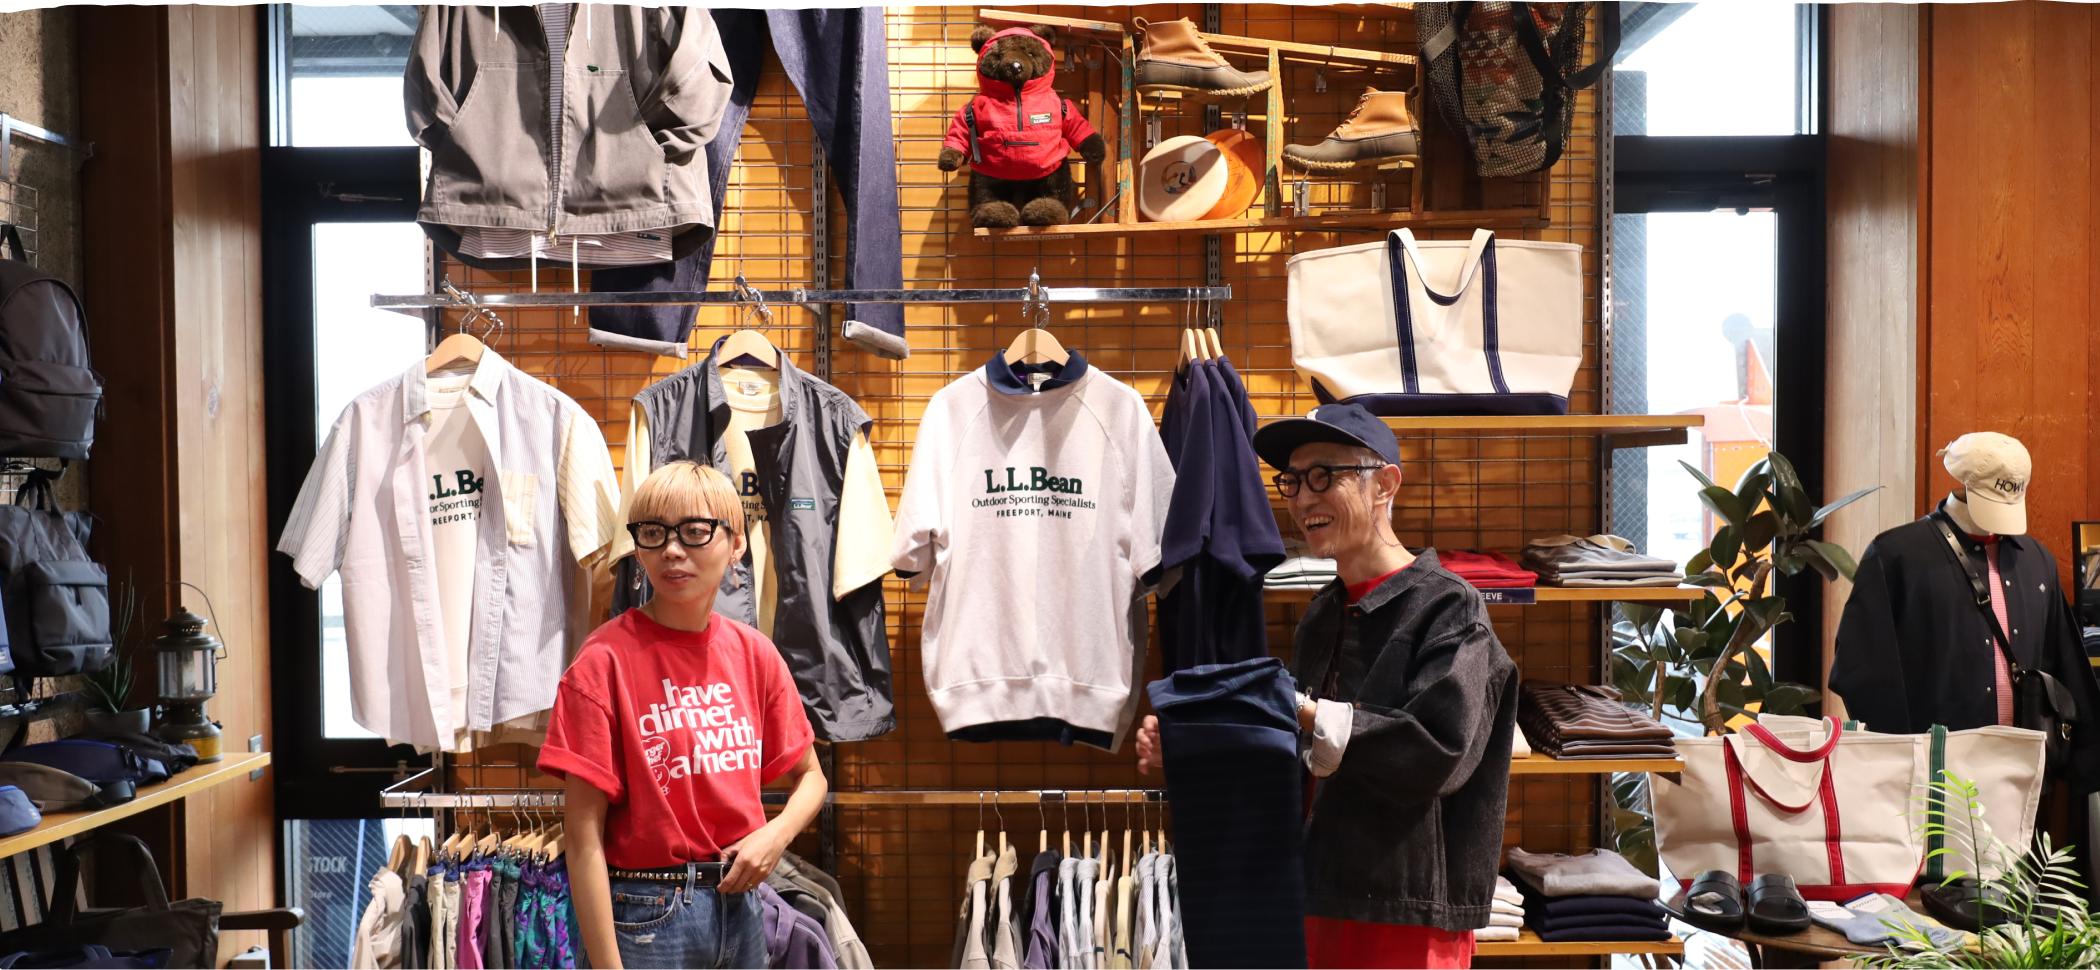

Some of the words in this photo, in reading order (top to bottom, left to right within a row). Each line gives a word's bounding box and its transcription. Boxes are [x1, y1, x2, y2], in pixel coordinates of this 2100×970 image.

[984, 466, 1082, 494] L.L.Bean
[439, 497, 481, 513] Sporting
[971, 497, 1008, 508] Outdoor
[1008, 494, 1050, 506] Sporting
[1050, 495, 1096, 510] Specialists
[996, 508, 1044, 518] FREEPORT,
[1047, 509, 1072, 520] MAINE
[662, 678, 733, 708] have
[639, 703, 736, 737] dinner
[696, 717, 755, 752] with
[670, 755, 692, 779] a
